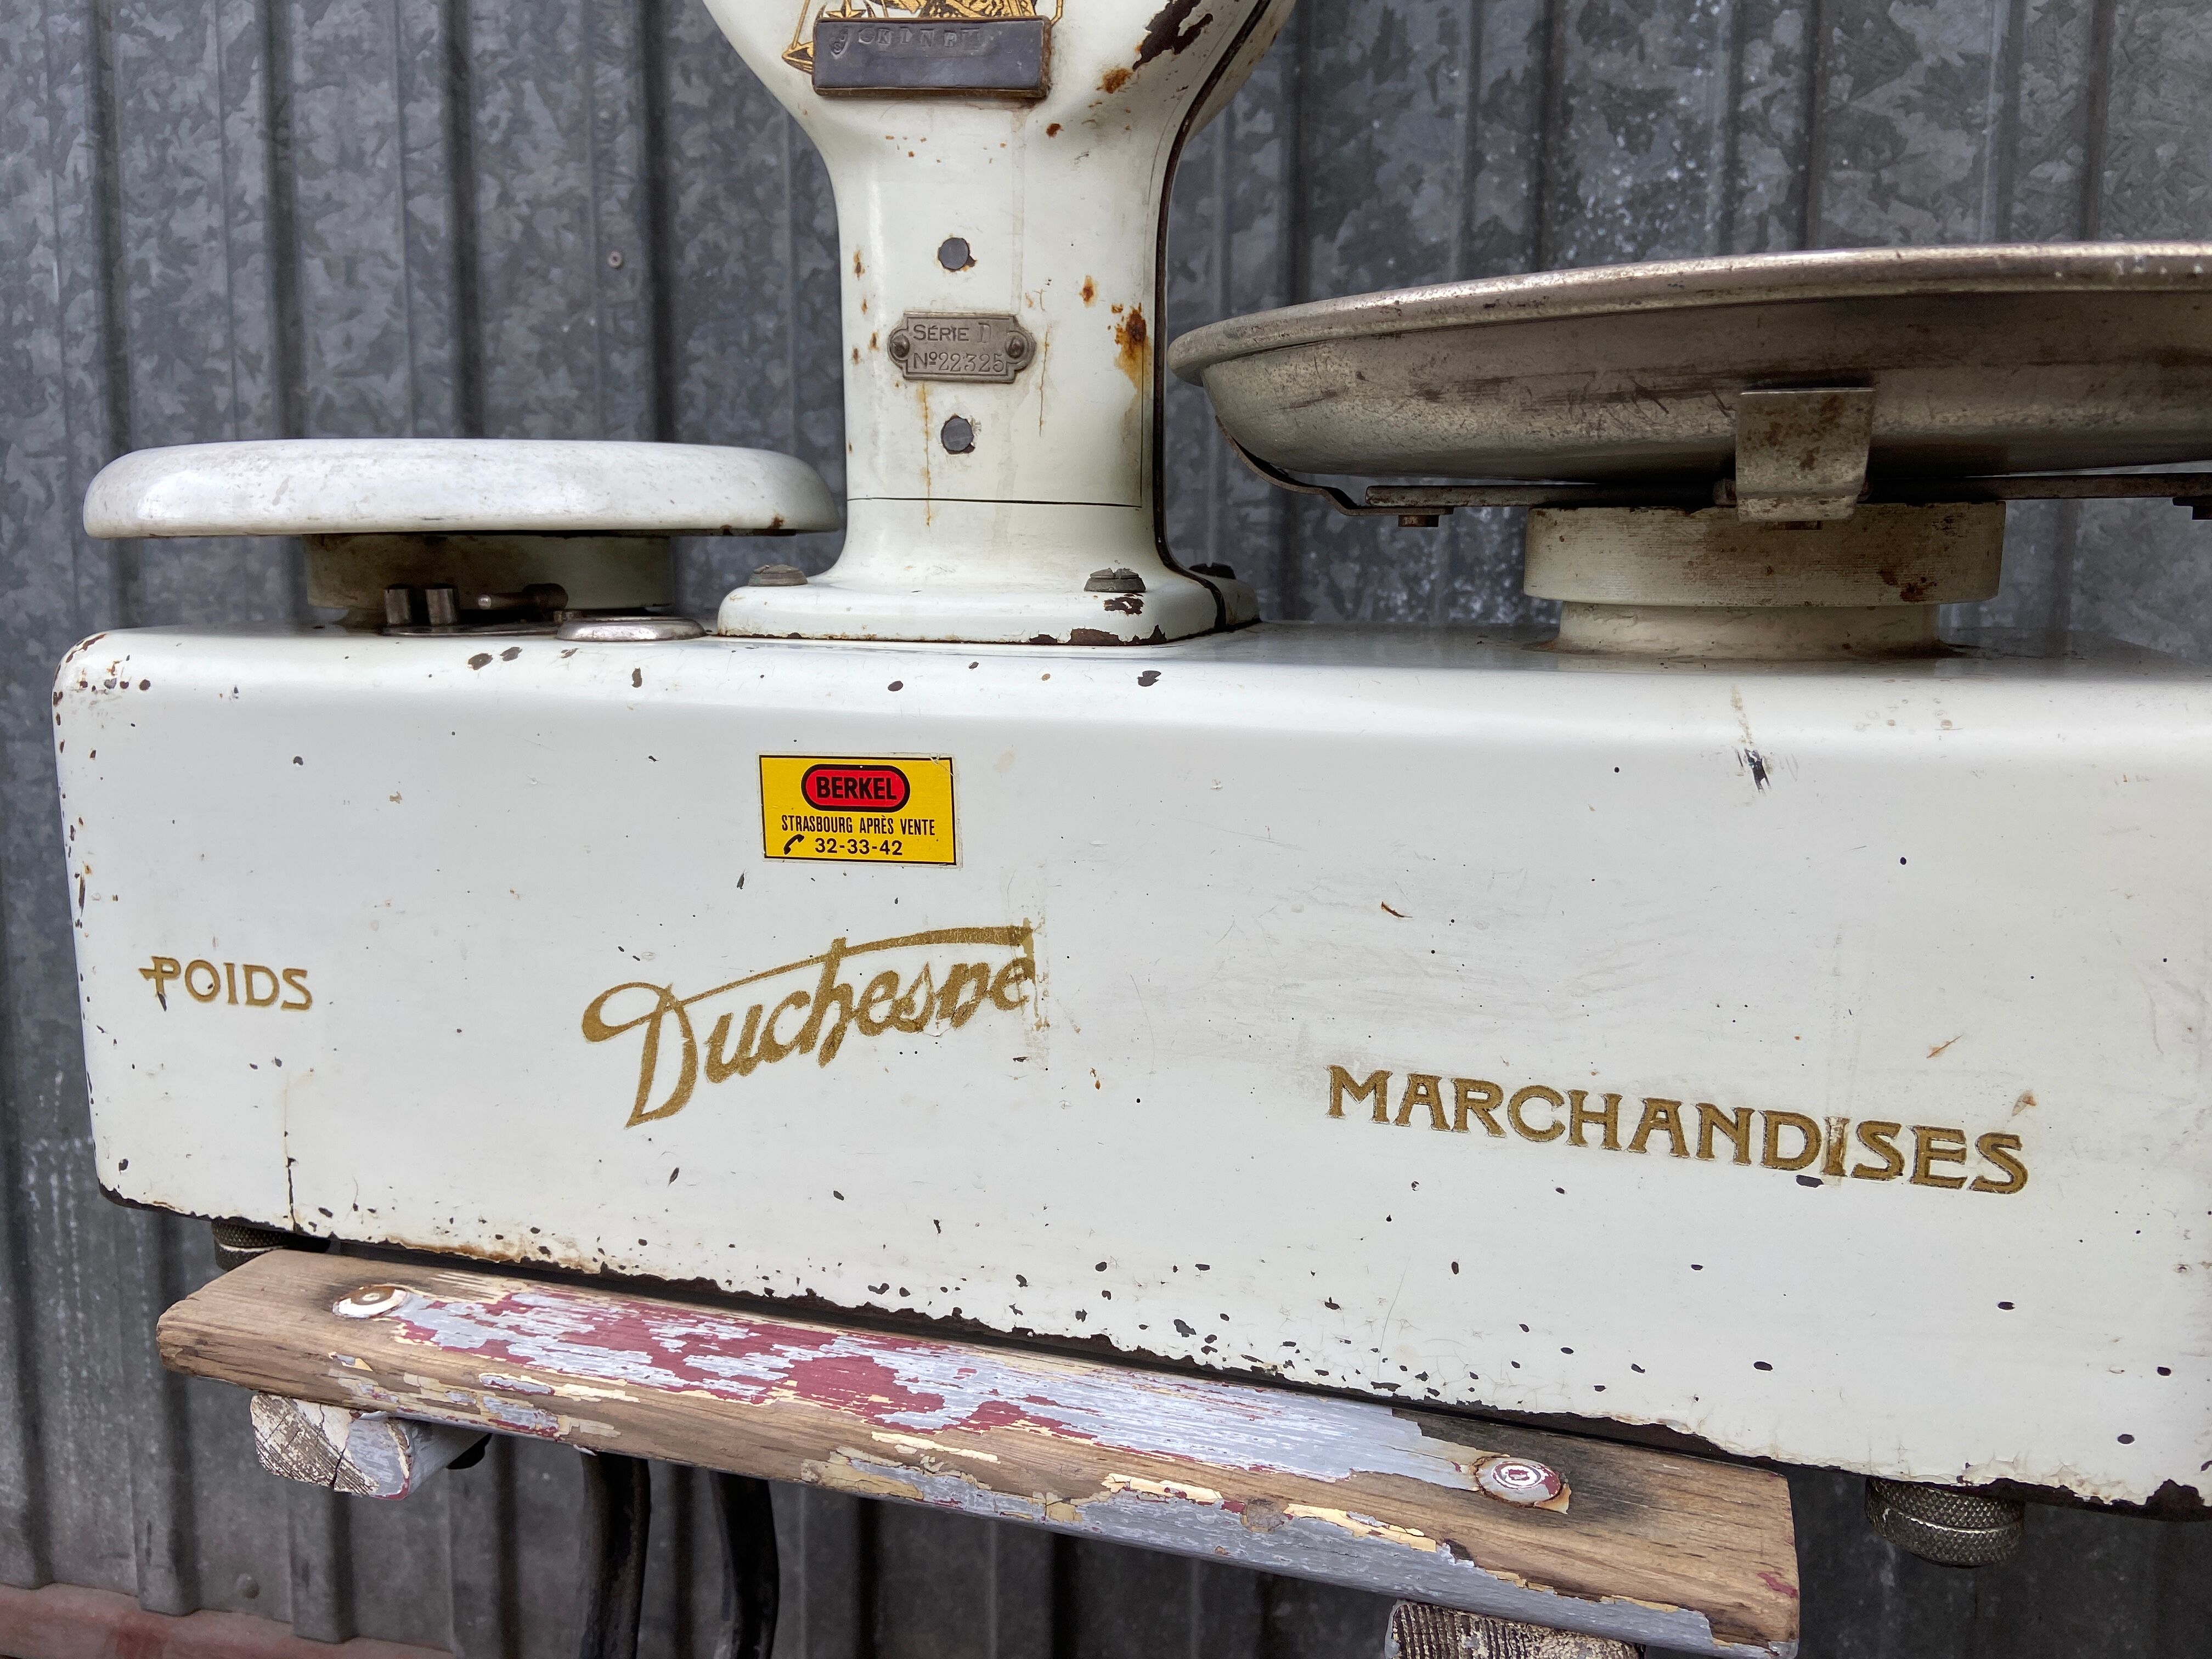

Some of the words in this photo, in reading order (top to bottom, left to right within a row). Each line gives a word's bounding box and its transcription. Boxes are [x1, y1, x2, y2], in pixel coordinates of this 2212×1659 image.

[816, 776, 897, 800] BERKEL
[781, 815, 853, 833] STRASBOURG
[859, 815, 894, 834] APRÈS
[900, 818, 935, 836] VENTE
[815, 837, 903, 856] 32-33-42
[138, 956, 313, 1012] POIDS
[582, 917, 1038, 1129] Duchesne
[1323, 1064, 2029, 1195] MARCHANDISES
